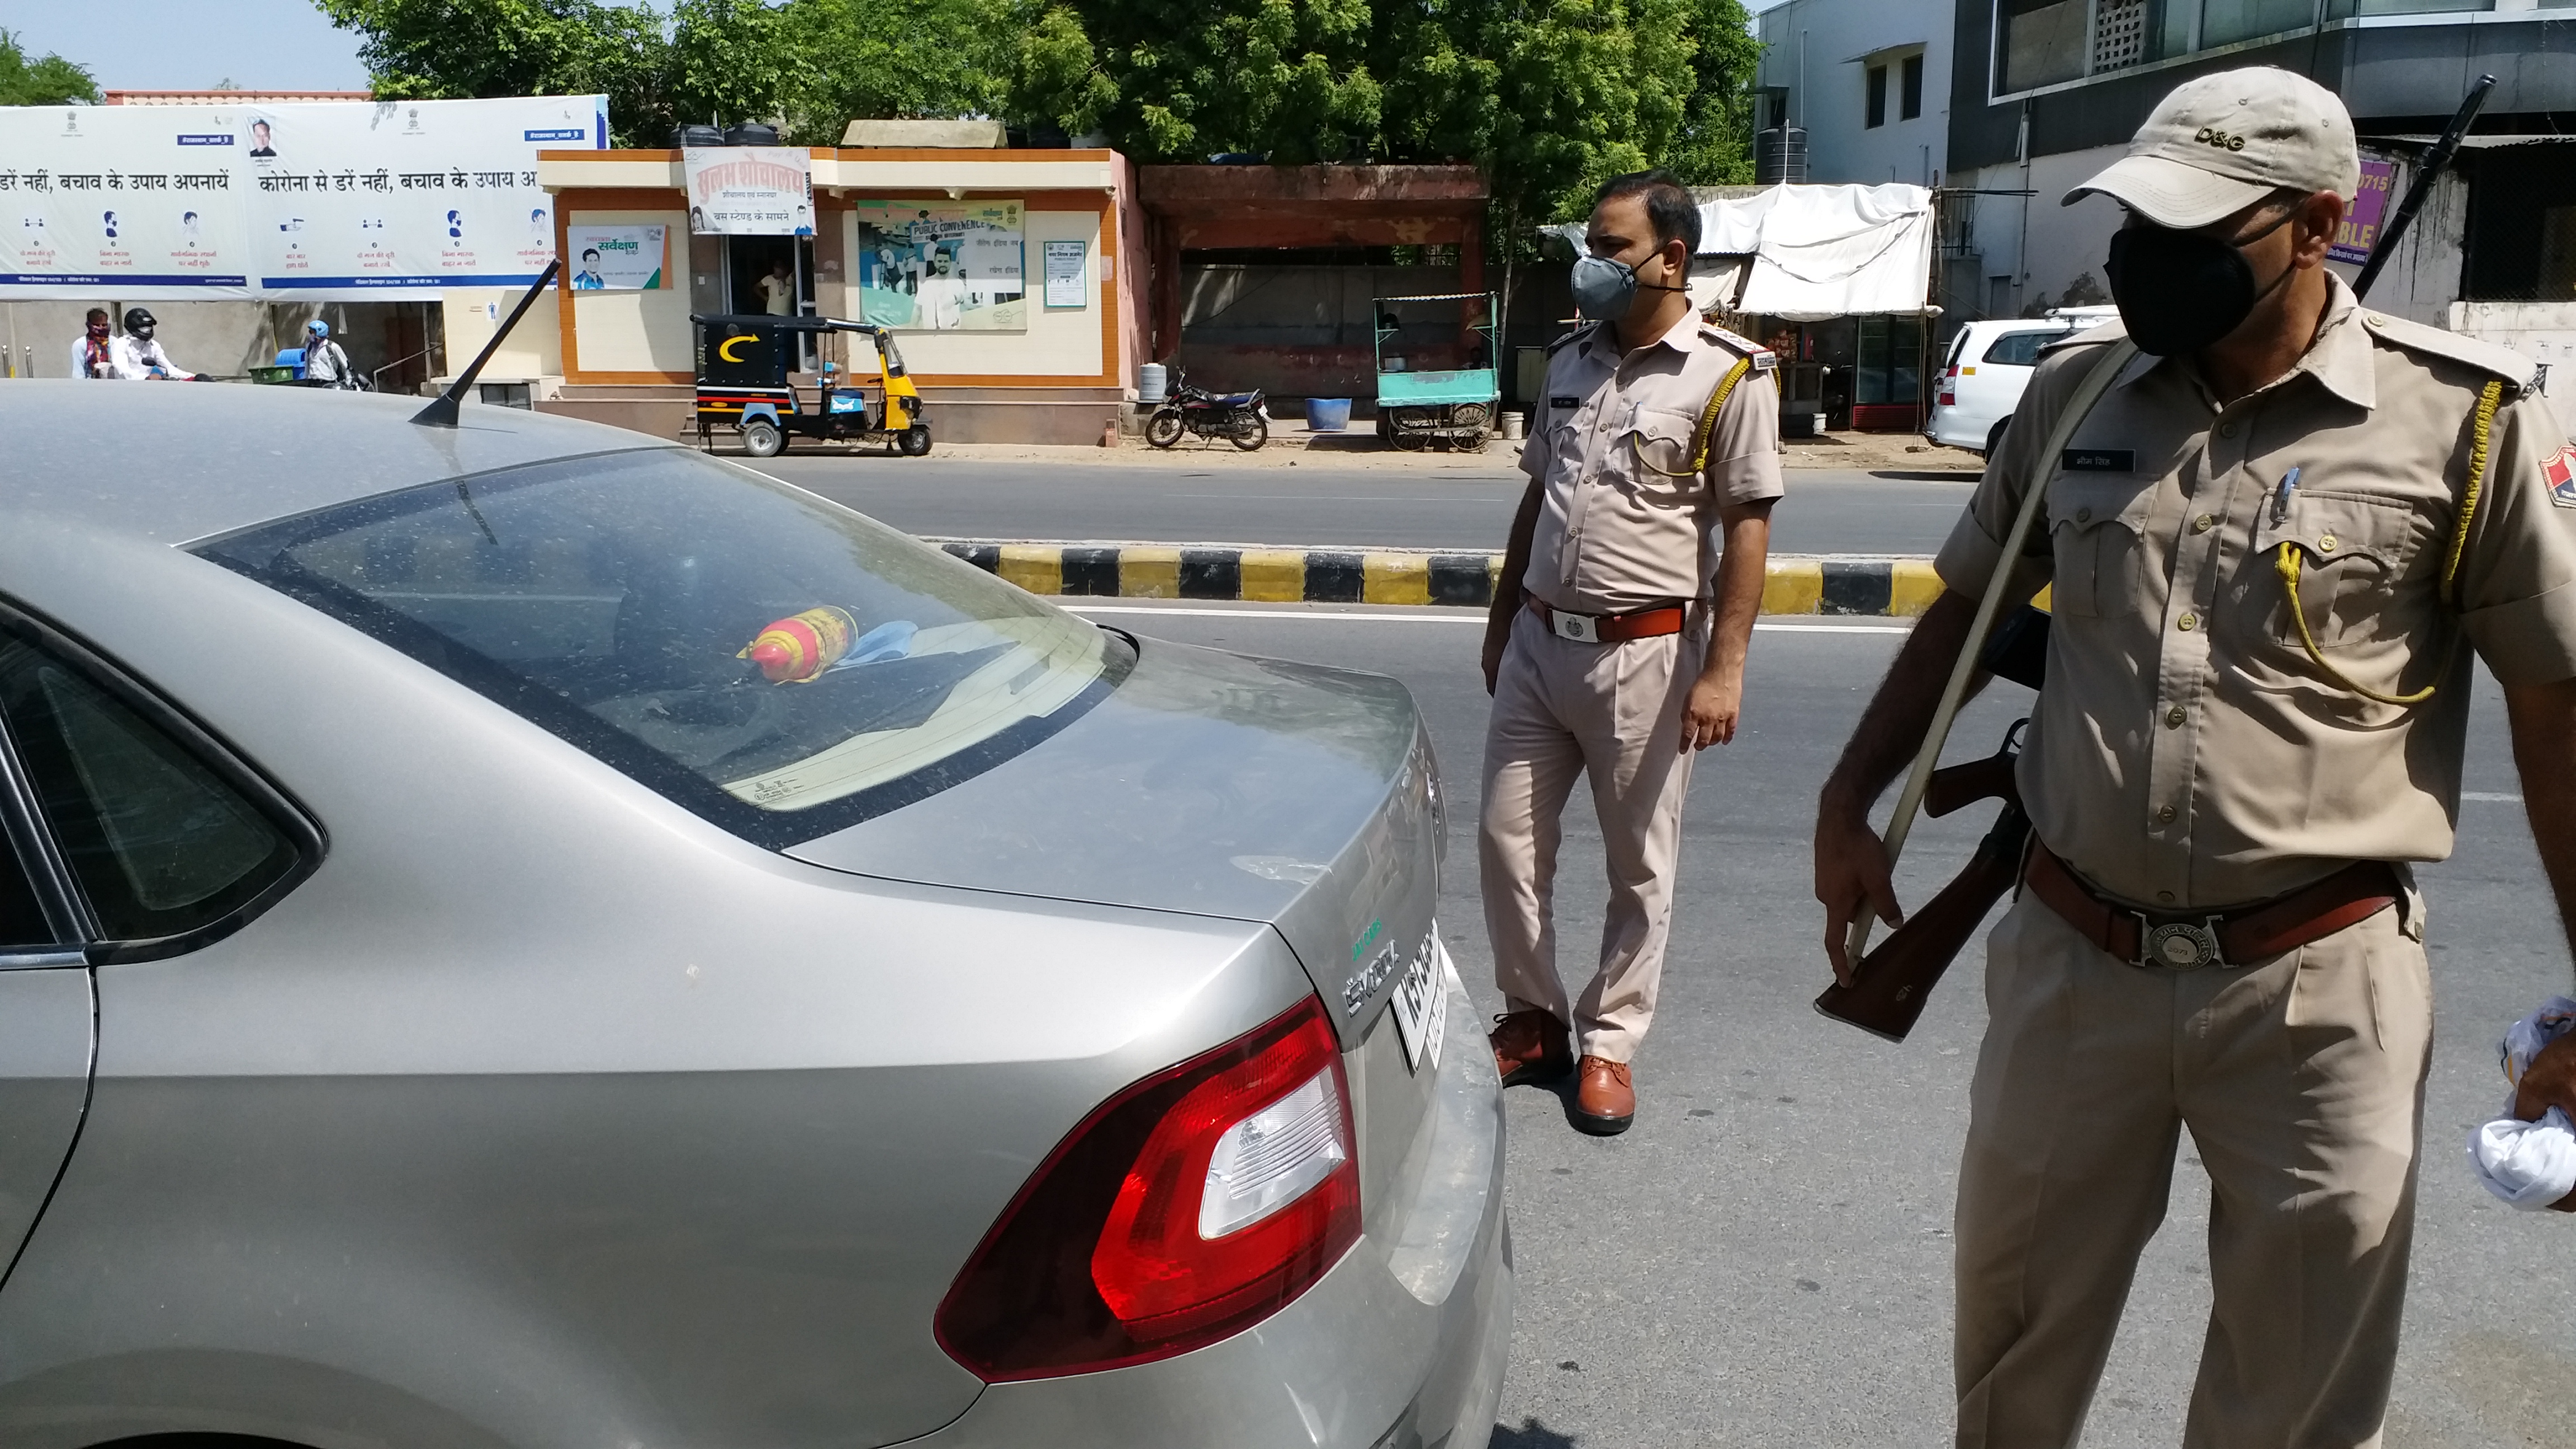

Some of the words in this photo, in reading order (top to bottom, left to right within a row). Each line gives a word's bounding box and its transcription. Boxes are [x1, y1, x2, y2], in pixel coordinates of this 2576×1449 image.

[2194, 126, 2245, 151] D&G
[21, 169, 53, 194] नहीं,
[58, 174, 102, 190] बचाव
[106, 169, 124, 191] के
[128, 174, 168, 190] उपाय
[173, 168, 229, 191] अपनायें
[258, 170, 310, 192] कोरोना
[313, 169, 329, 192] से
[332, 169, 357, 191] डरें
[359, 168, 394, 194] नहीं,
[399, 173, 446, 190] बचाव
[449, 167, 469, 189] के
[473, 171, 515, 188] उपाय
[714, 212, 727, 221] बस
[755, 210, 764, 221] के
[765, 210, 789, 221] सामने
[914, 224, 937, 235] PUBLIC
[598, 238, 640, 251] सर्वेक्षण
[2076, 456, 2092, 465] भीम
